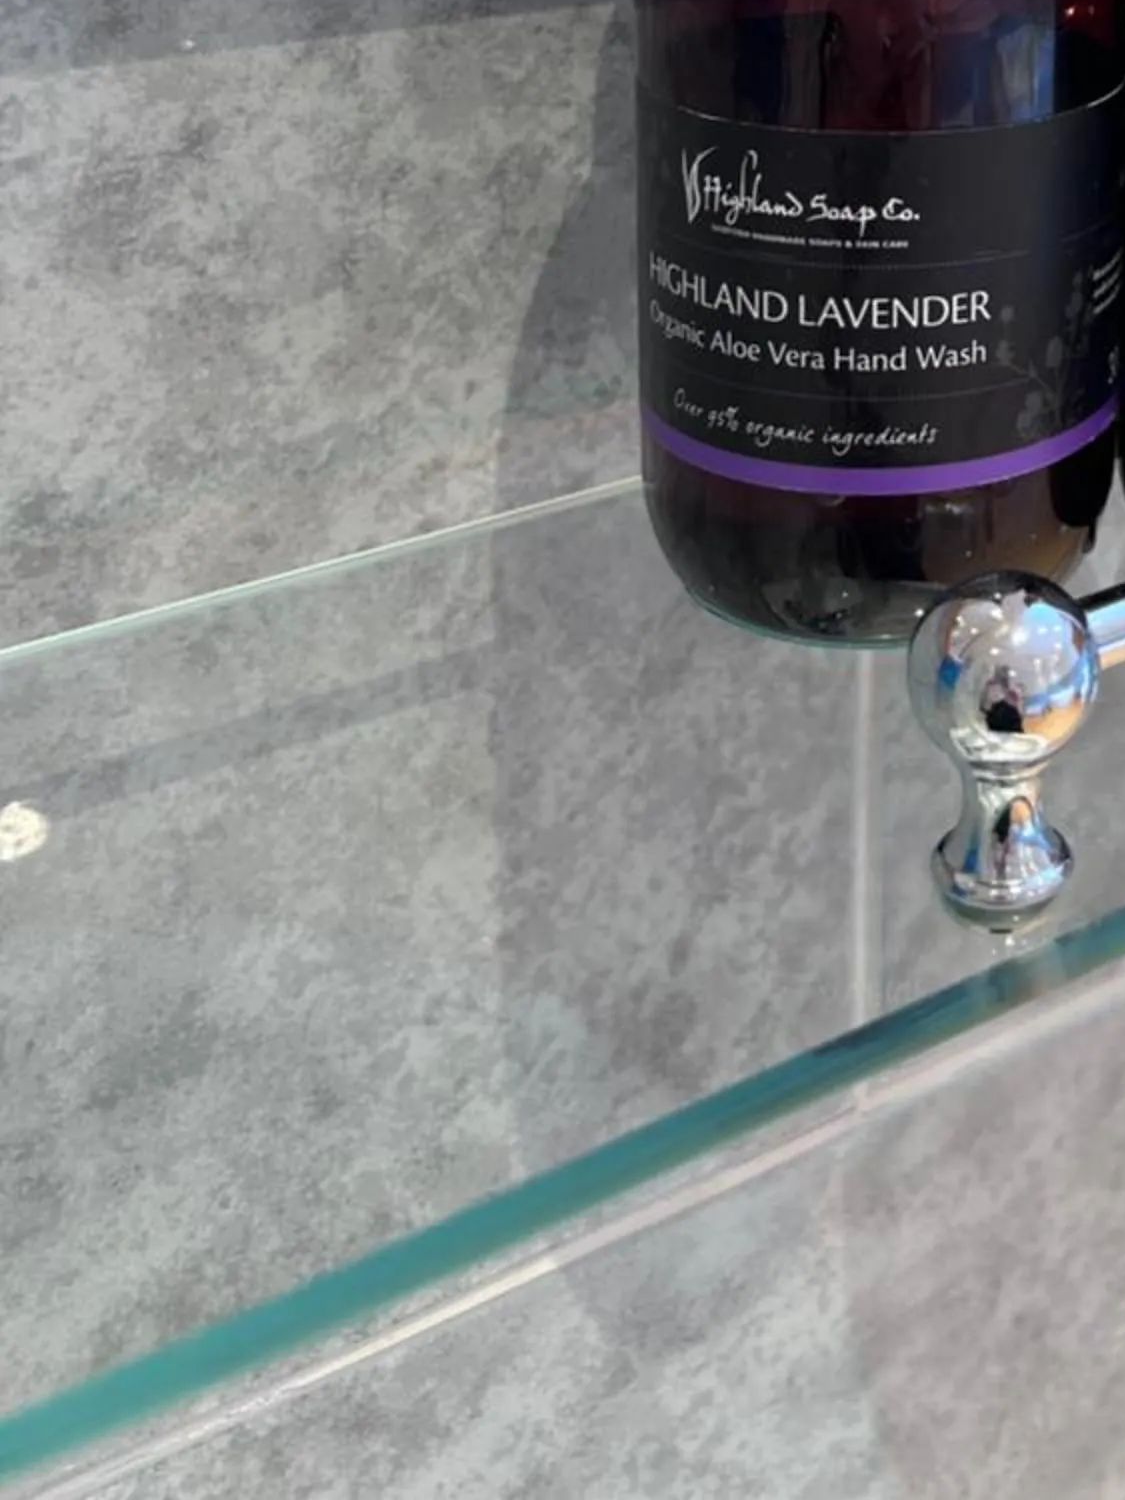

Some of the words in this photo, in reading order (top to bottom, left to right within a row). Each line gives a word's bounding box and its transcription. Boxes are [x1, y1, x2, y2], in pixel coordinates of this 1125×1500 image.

[703, 149, 804, 225] Highland
[806, 193, 877, 237] Soap
[881, 197, 921, 221] Co.
[650, 251, 789, 323] HIGHLAND
[799, 290, 992, 329] LAVENDER
[649, 299, 706, 350] Organic
[709, 329, 761, 362] Aloe
[768, 340, 826, 370] Vera
[834, 345, 907, 372] Hand
[916, 339, 987, 369] Wash
[673, 387, 703, 417] Over
[745, 419, 815, 448] organic
[822, 422, 941, 457] ingredients
